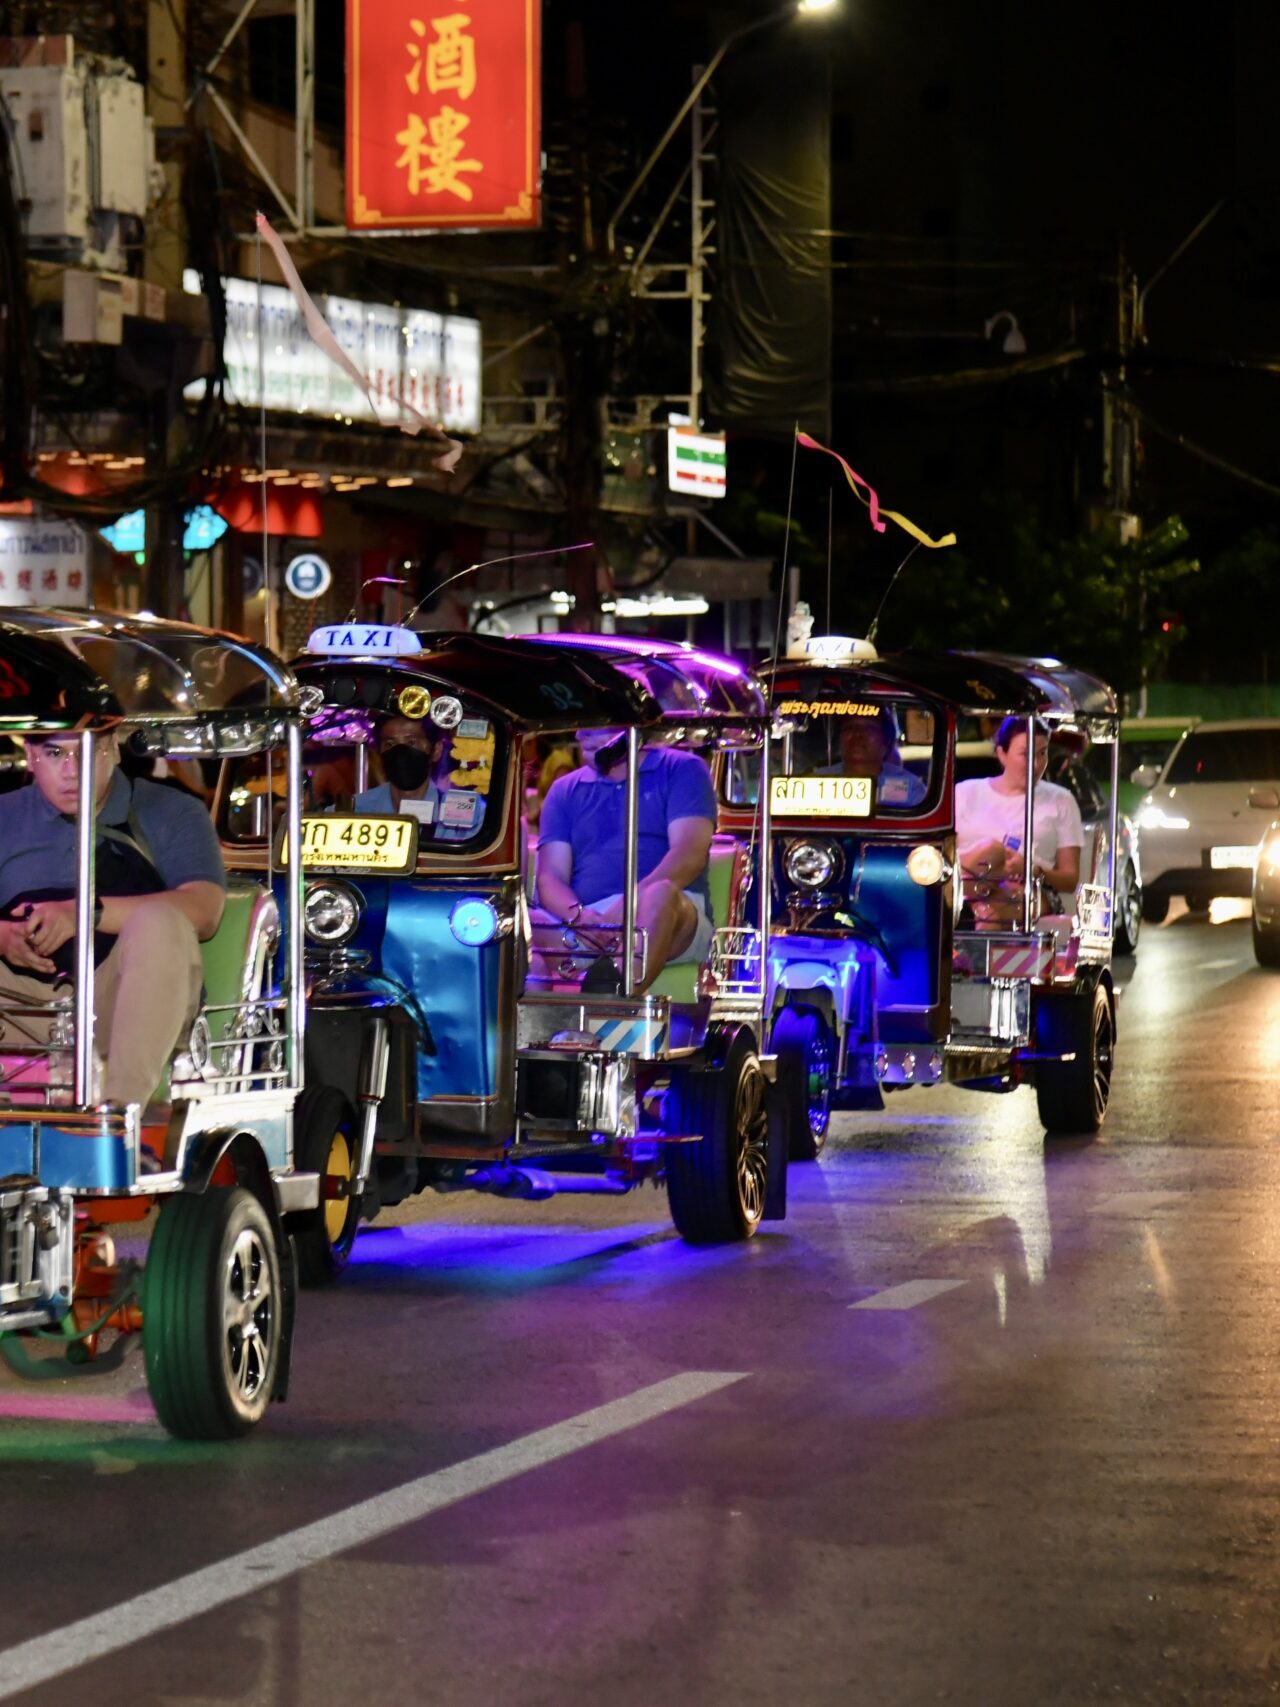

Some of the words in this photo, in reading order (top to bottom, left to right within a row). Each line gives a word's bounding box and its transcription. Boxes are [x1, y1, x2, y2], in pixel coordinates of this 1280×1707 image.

[394, 13, 483, 202] 酒樓
[327, 630, 394, 648] TAXI
[818, 780, 867, 800] 1103
[340, 822, 405, 848] 4891
